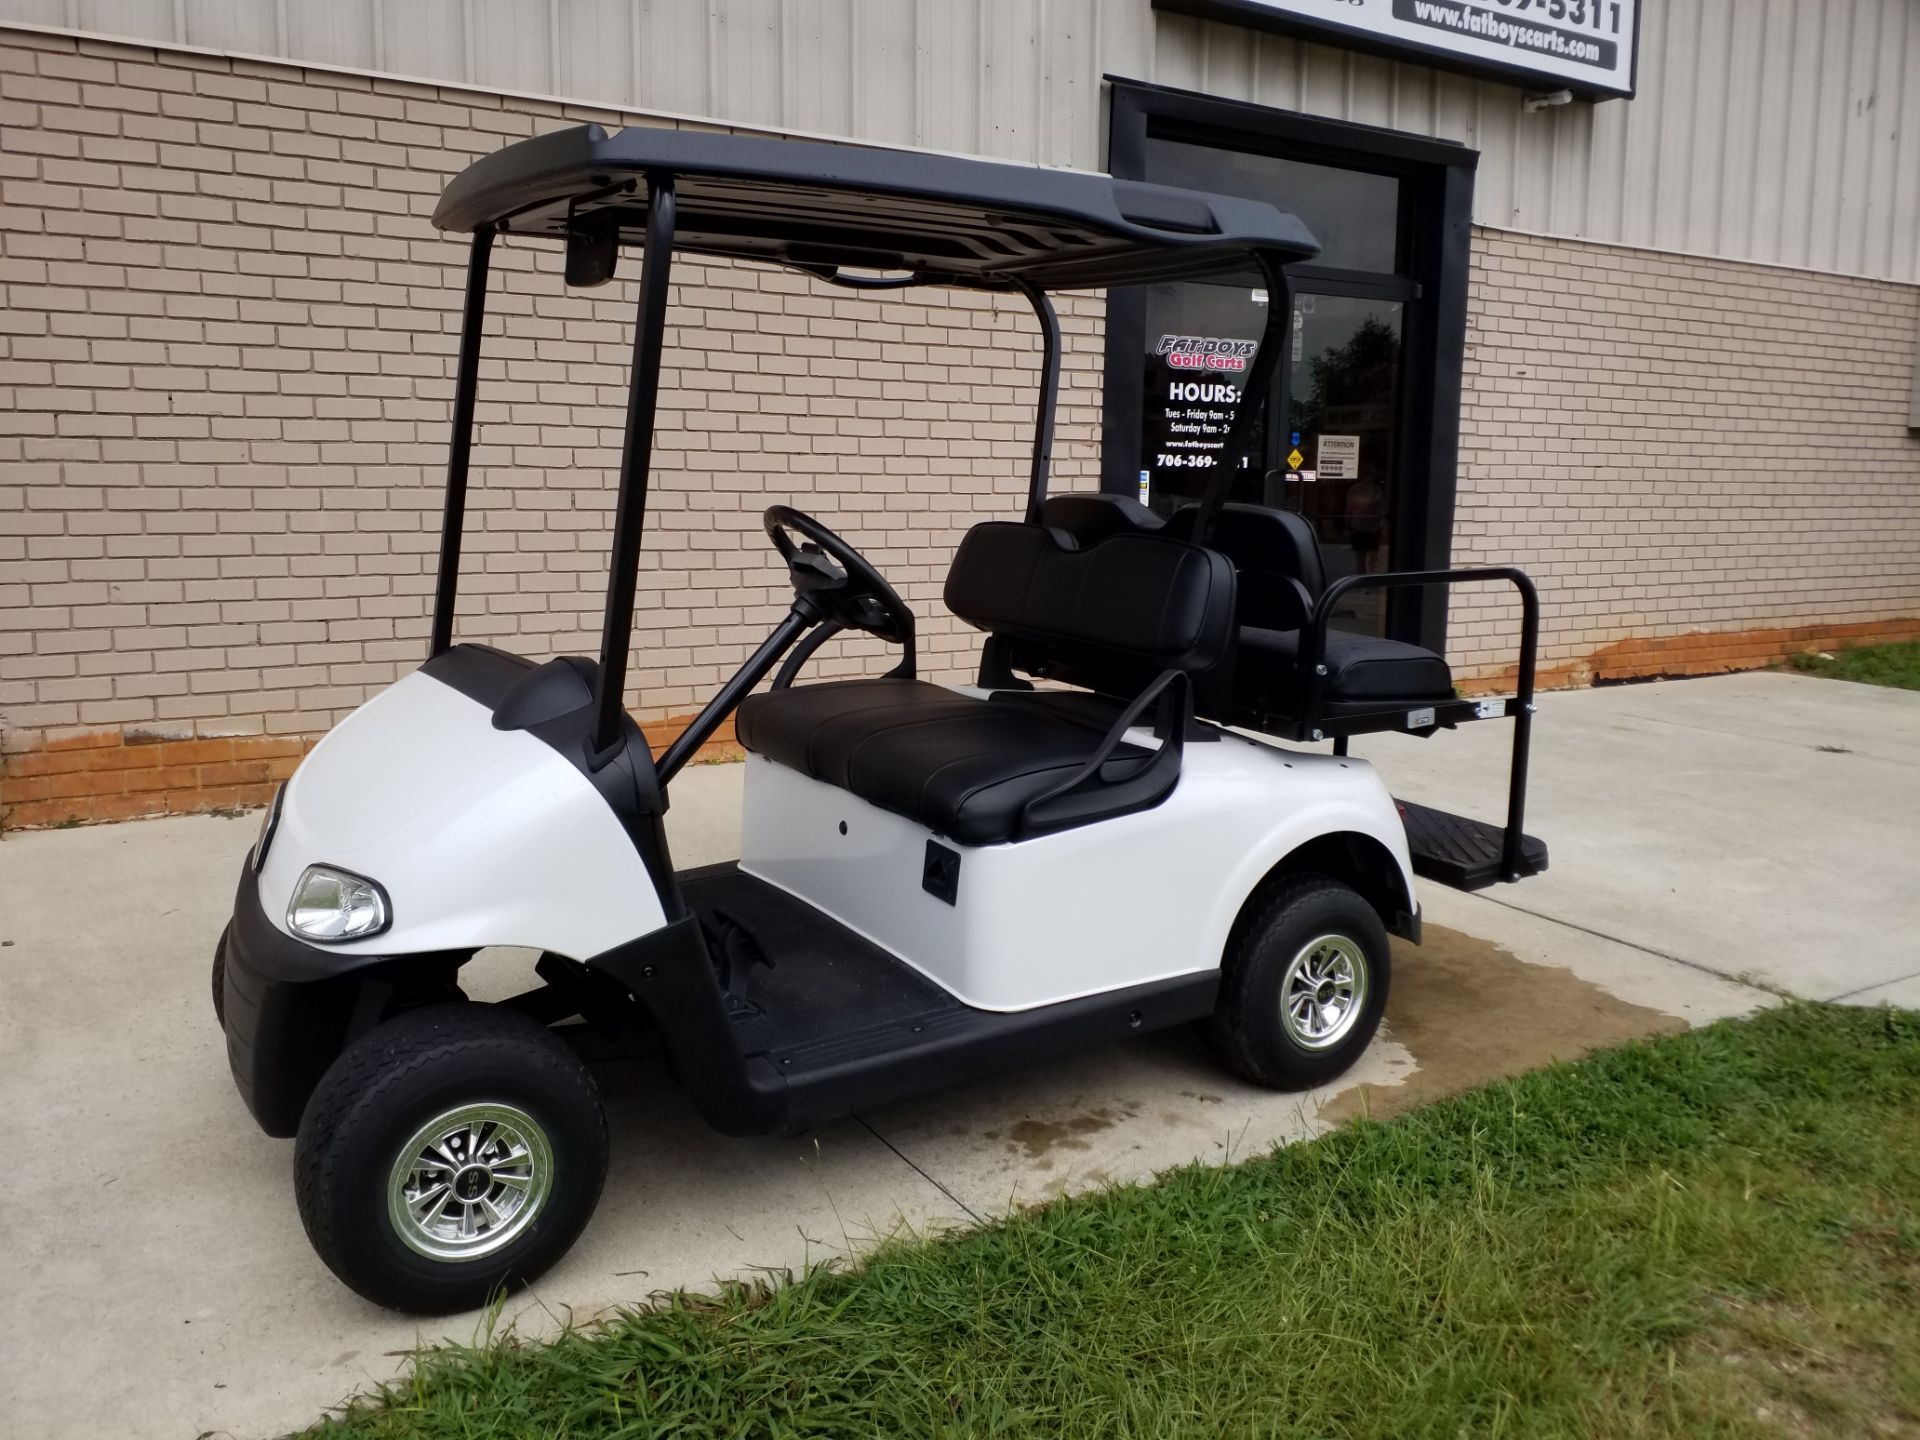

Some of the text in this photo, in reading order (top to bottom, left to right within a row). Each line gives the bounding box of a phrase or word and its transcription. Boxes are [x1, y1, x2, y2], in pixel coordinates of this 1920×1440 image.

[1415, 1, 1600, 61] www.fatboyscarts.com
[1159, 336, 1255, 357] FAT BOYS
[1169, 352, 1245, 369] Golf Carts
[1169, 382, 1241, 403] HOURS:
[1165, 408, 1181, 418] Tues
[1187, 409, 1208, 421] Friday
[1209, 410, 1224, 420] 9am
[1170, 422, 1201, 435] Saturday
[1203, 423, 1217, 433] 9am
[1322, 440, 1355, 449] ATTENTION
